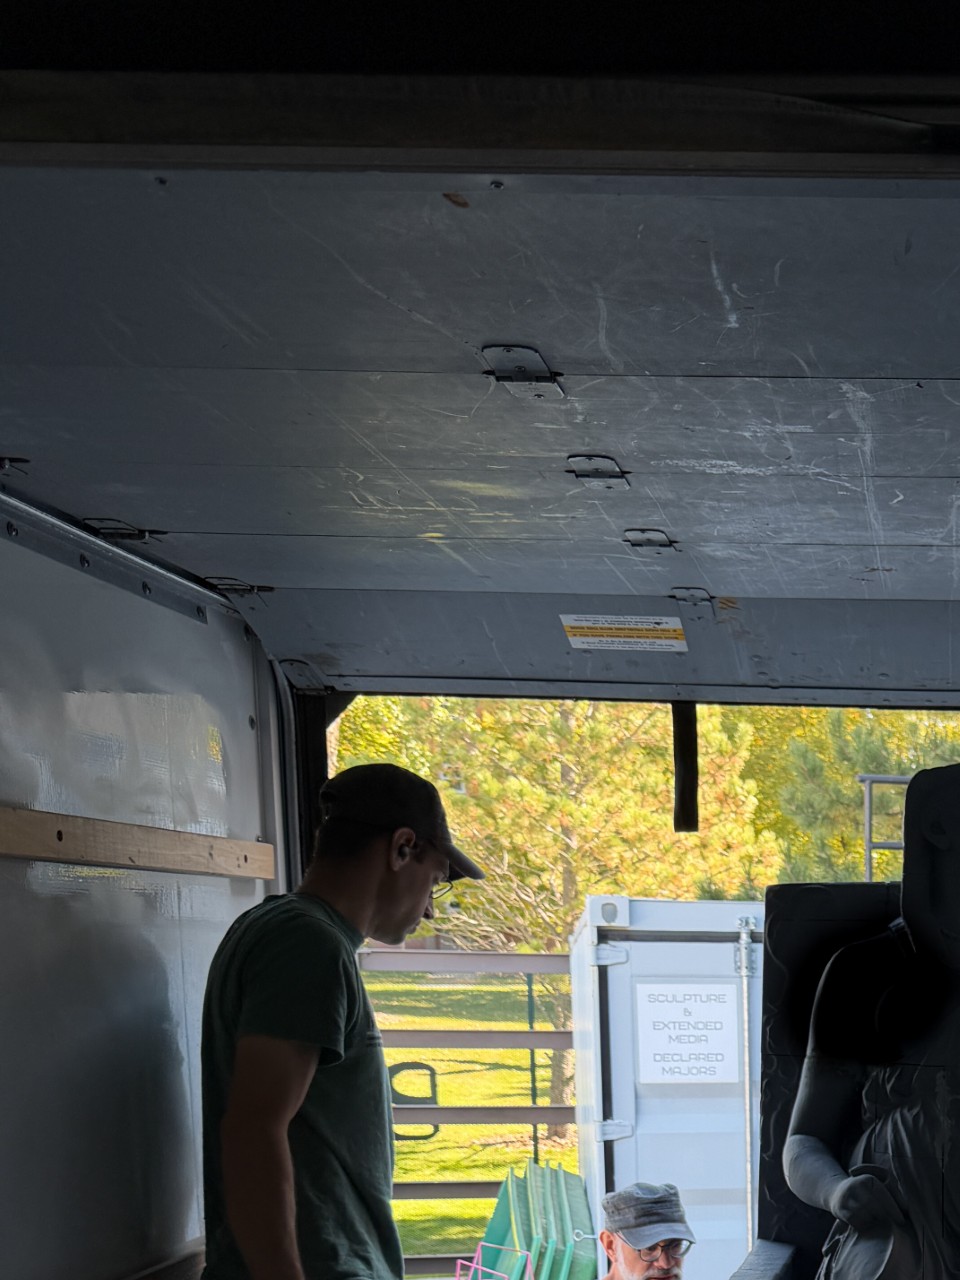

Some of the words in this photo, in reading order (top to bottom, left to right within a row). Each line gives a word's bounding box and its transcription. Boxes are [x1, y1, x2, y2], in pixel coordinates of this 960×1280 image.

[647, 993, 728, 1004] SCULPTURE
[683, 1008, 692, 1017] &
[652, 1021, 724, 1031] EXTENDED
[667, 1034, 709, 1044] MEDIA
[652, 1052, 725, 1063] DECLARED
[661, 1066, 717, 1076] MAJORS
